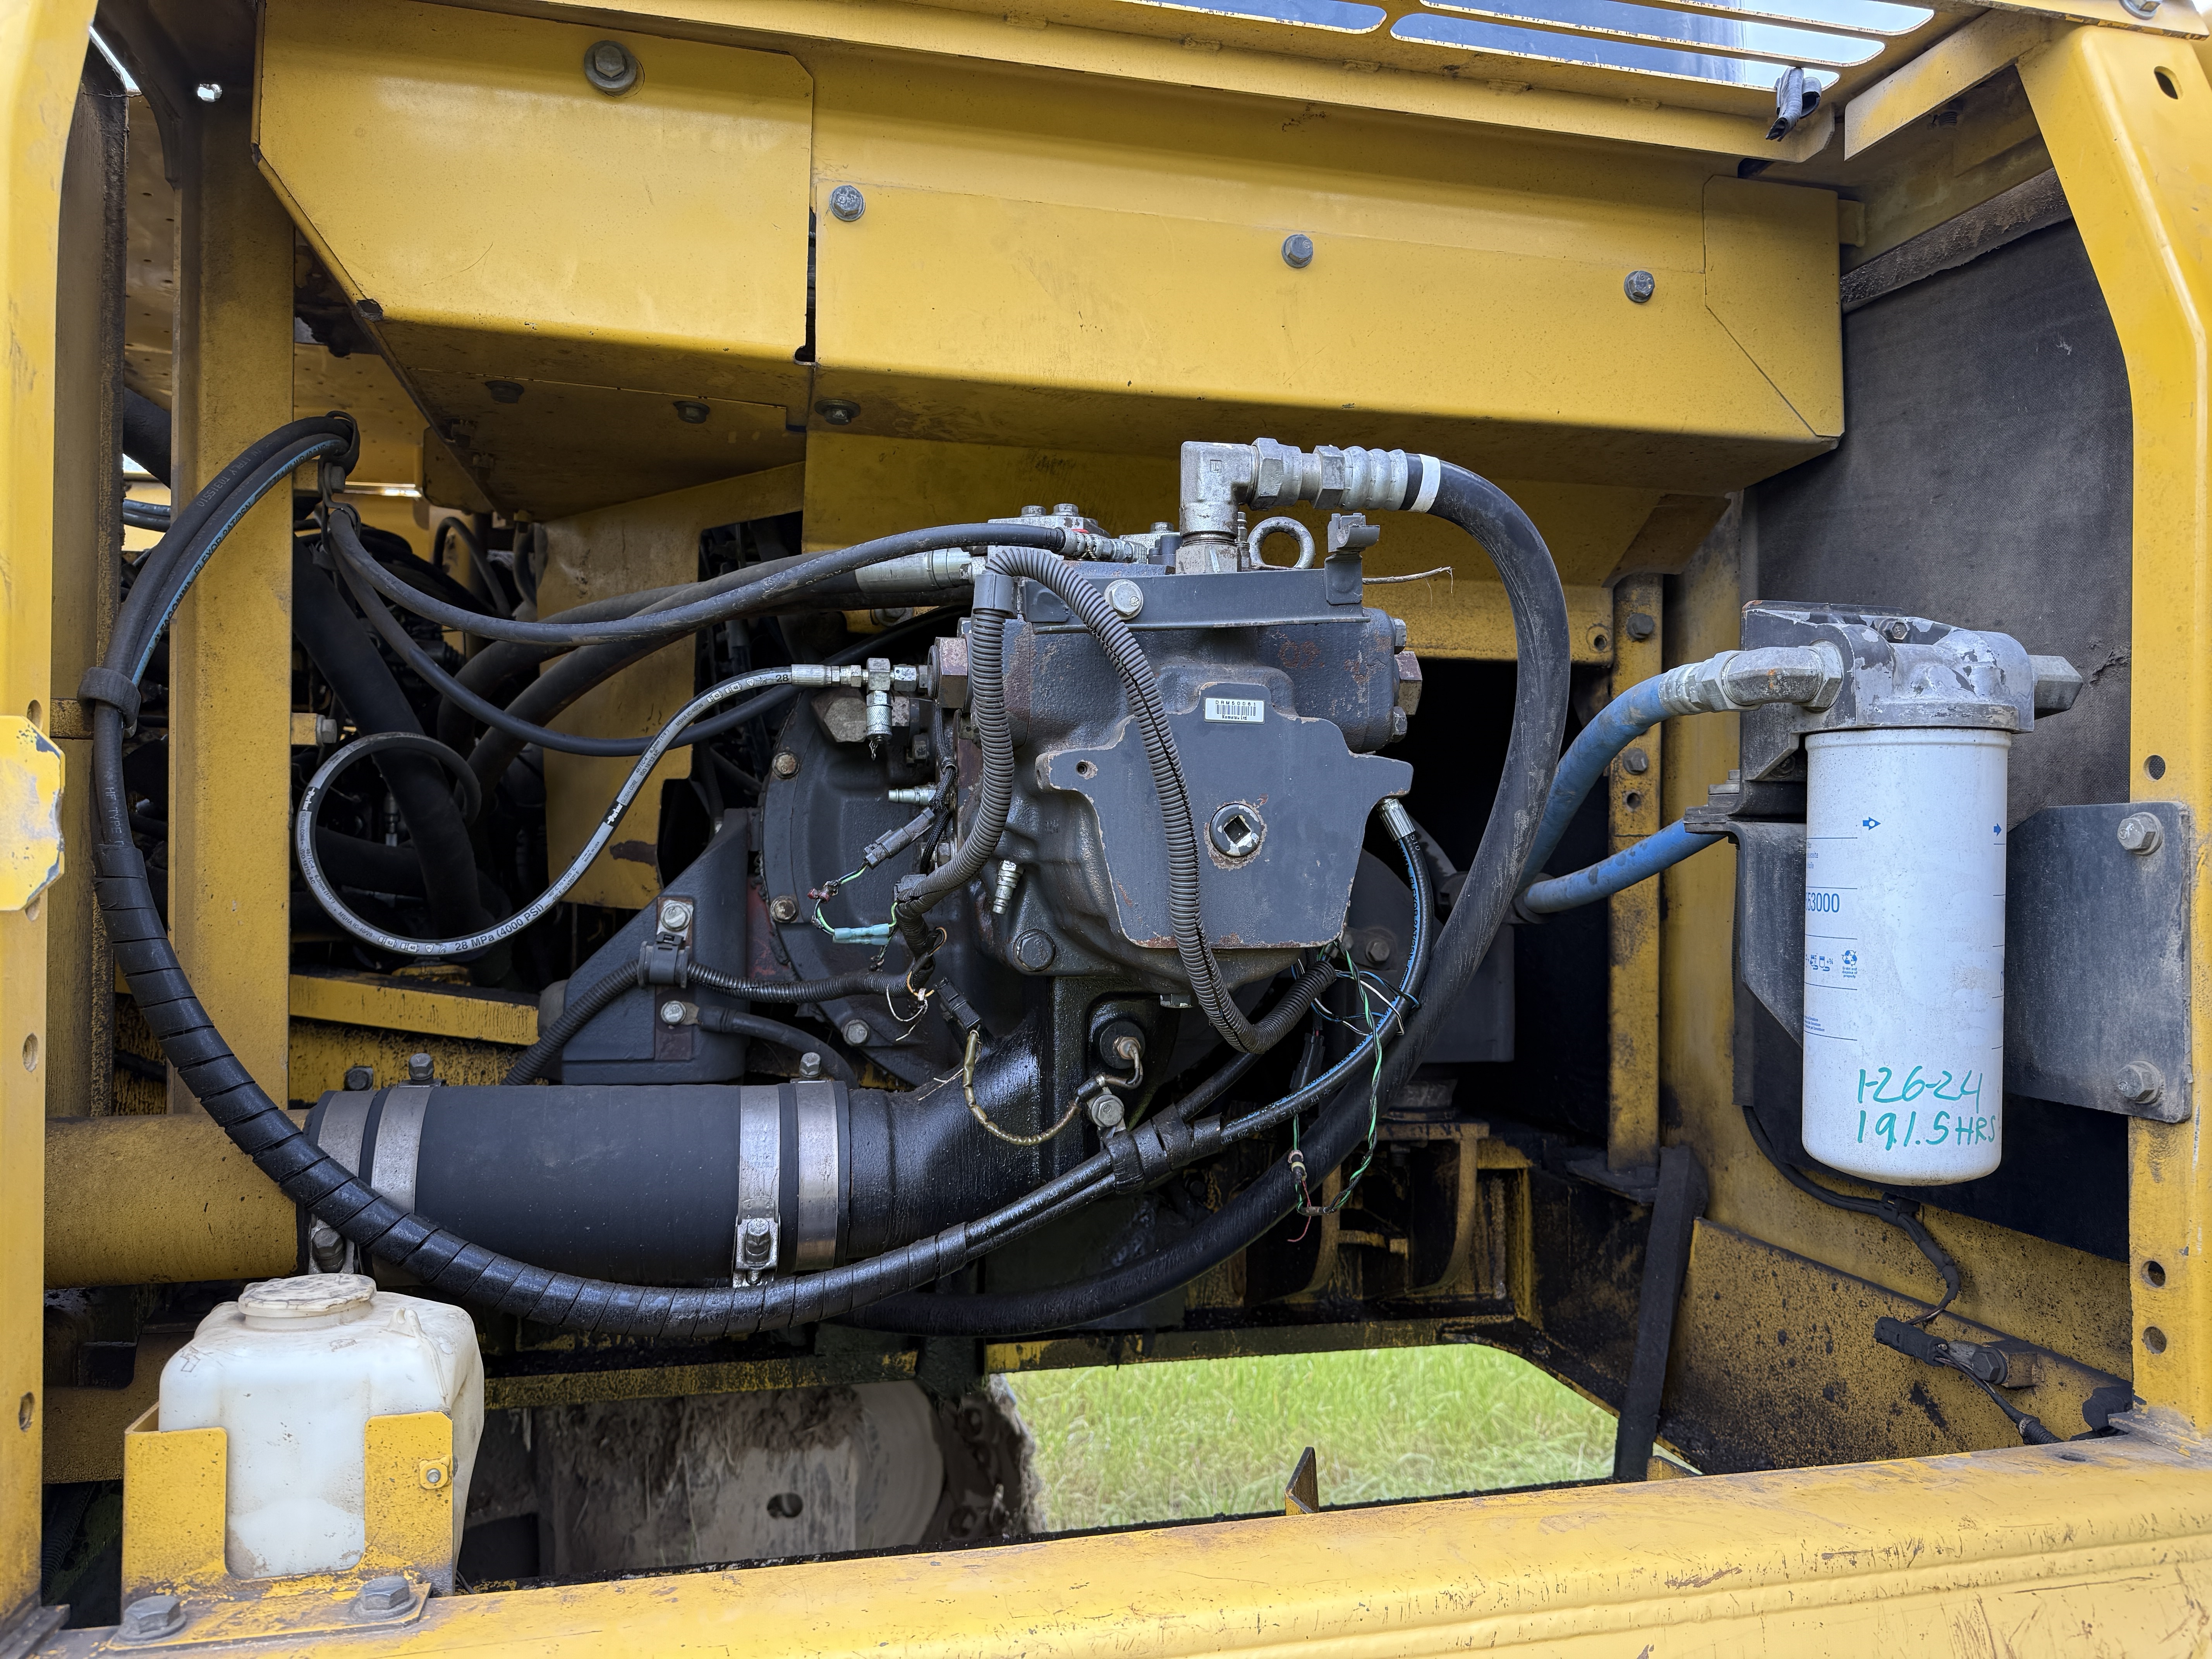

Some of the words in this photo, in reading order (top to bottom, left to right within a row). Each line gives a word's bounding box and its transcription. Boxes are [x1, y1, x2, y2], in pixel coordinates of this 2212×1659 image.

[229, 457, 251, 475] ITALY
[302, 787, 316, 811] Parker
[607, 803, 623, 824] Parker
[455, 941, 468, 951] 28
[471, 934, 495, 948] MPa
[496, 918, 524, 938] (4000
[524, 903, 544, 922] PSI)
[1858, 1065, 1983, 1114] 1-26-24
[1955, 1115, 1996, 1146] HRS
